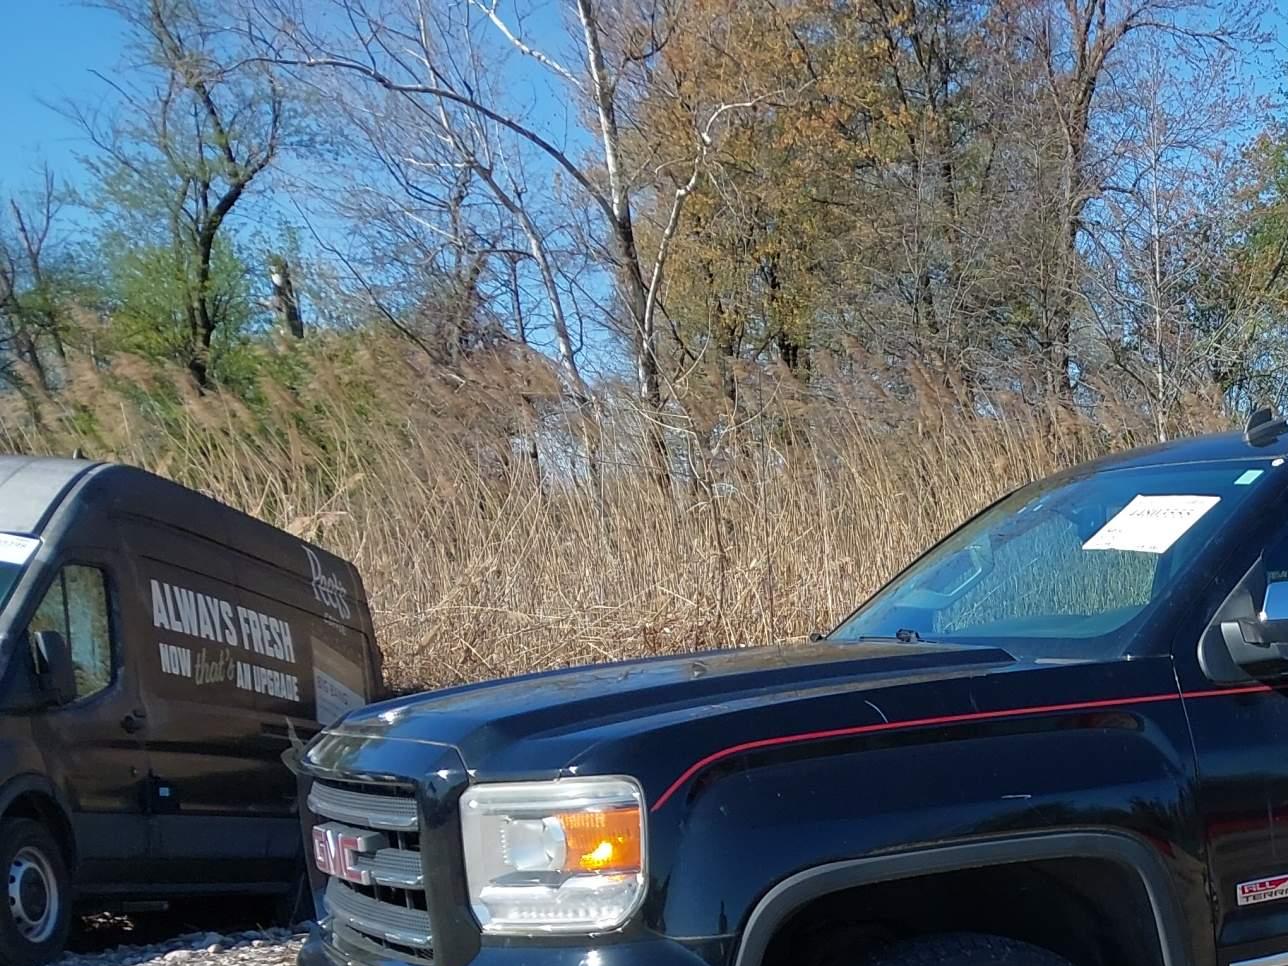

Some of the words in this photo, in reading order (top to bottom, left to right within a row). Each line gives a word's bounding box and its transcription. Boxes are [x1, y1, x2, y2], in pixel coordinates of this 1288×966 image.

[150, 579, 238, 646] ALWAYS
[236, 605, 296, 664] FRESH
[159, 642, 191, 678] NOW
[195, 647, 235, 686] that's
[236, 660, 251, 692] AN
[252, 664, 300, 702] UPGRADE
[312, 825, 370, 886] GMC
[1243, 881, 1276, 893] ALL
